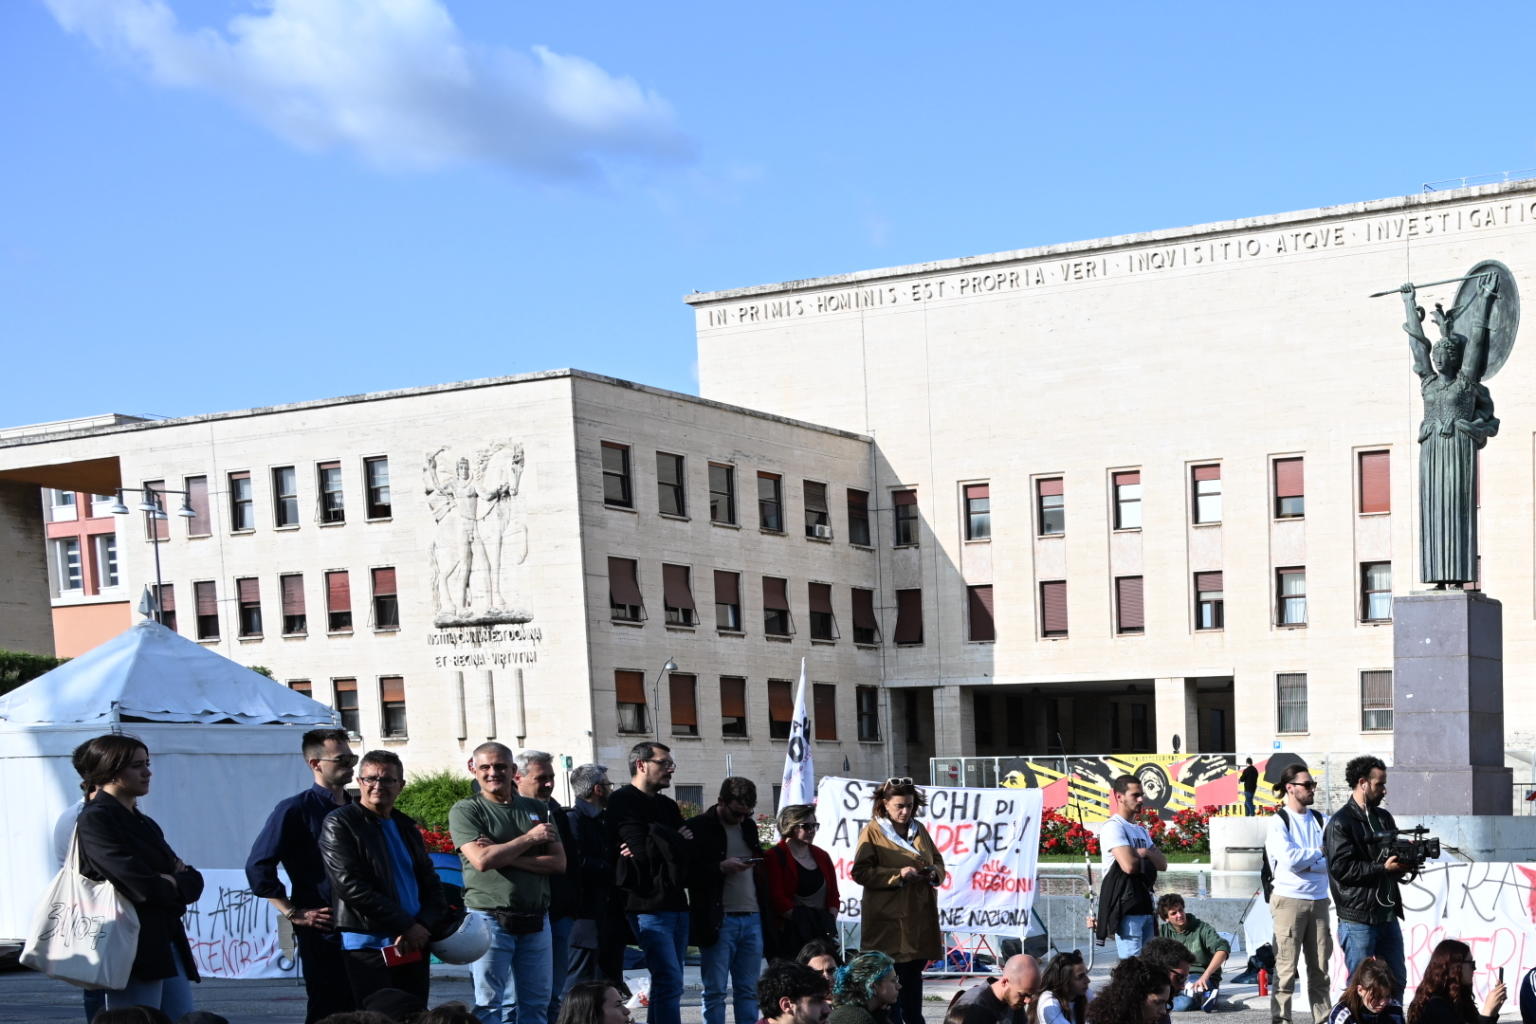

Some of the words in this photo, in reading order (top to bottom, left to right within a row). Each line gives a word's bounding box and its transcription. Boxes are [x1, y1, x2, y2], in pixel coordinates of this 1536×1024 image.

[708, 309, 728, 327] IN
[737, 299, 805, 323] PRIMIS
[816, 286, 898, 313] HOMINIS
[911, 279, 945, 302] EST
[959, 267, 1045, 295] PROPRIA
[1060, 258, 1108, 282] VERI
[1128, 239, 1262, 274] INQVISITIO
[1276, 226, 1346, 254] ATQVE
[995, 799, 1015, 816] DI
[972, 871, 1032, 893] REGIONI
